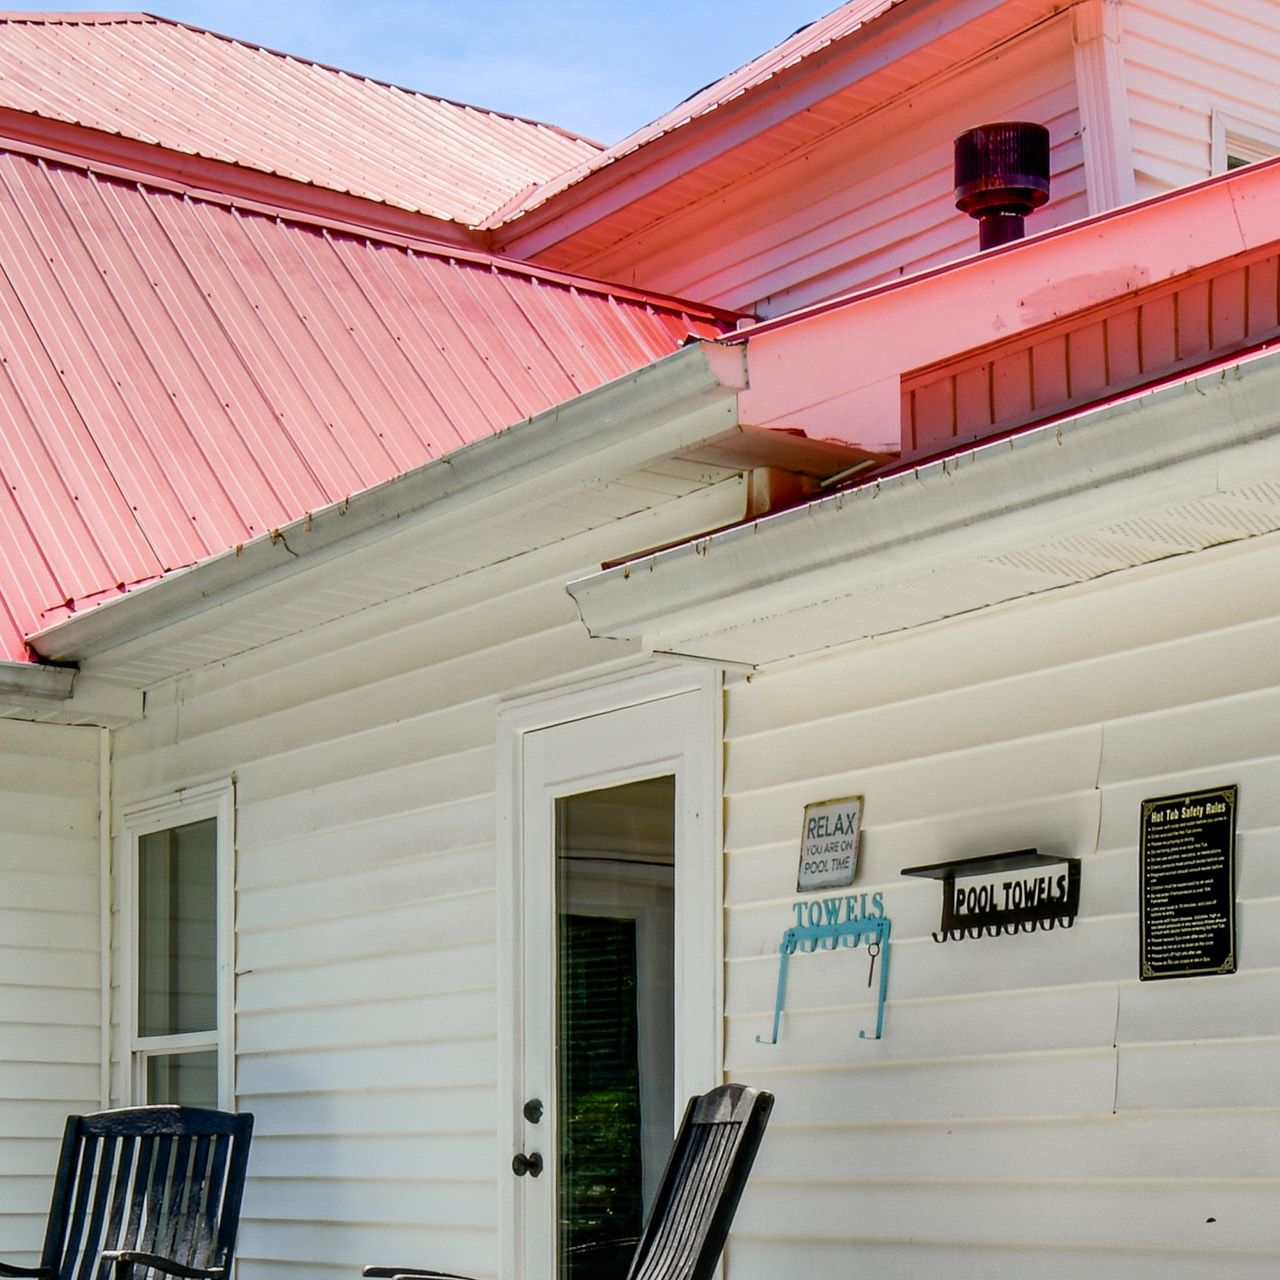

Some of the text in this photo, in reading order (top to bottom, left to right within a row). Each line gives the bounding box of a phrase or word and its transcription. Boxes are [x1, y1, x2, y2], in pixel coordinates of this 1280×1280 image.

[1151, 802, 1226, 823] Hot Tub Safety Rules
[807, 812, 856, 840] RELAX
[806, 840, 853, 856] YOU ARE ON
[804, 856, 850, 875] POOL TIME
[955, 874, 1067, 915] POOL TOWELS
[792, 892, 885, 928] TOWELS
